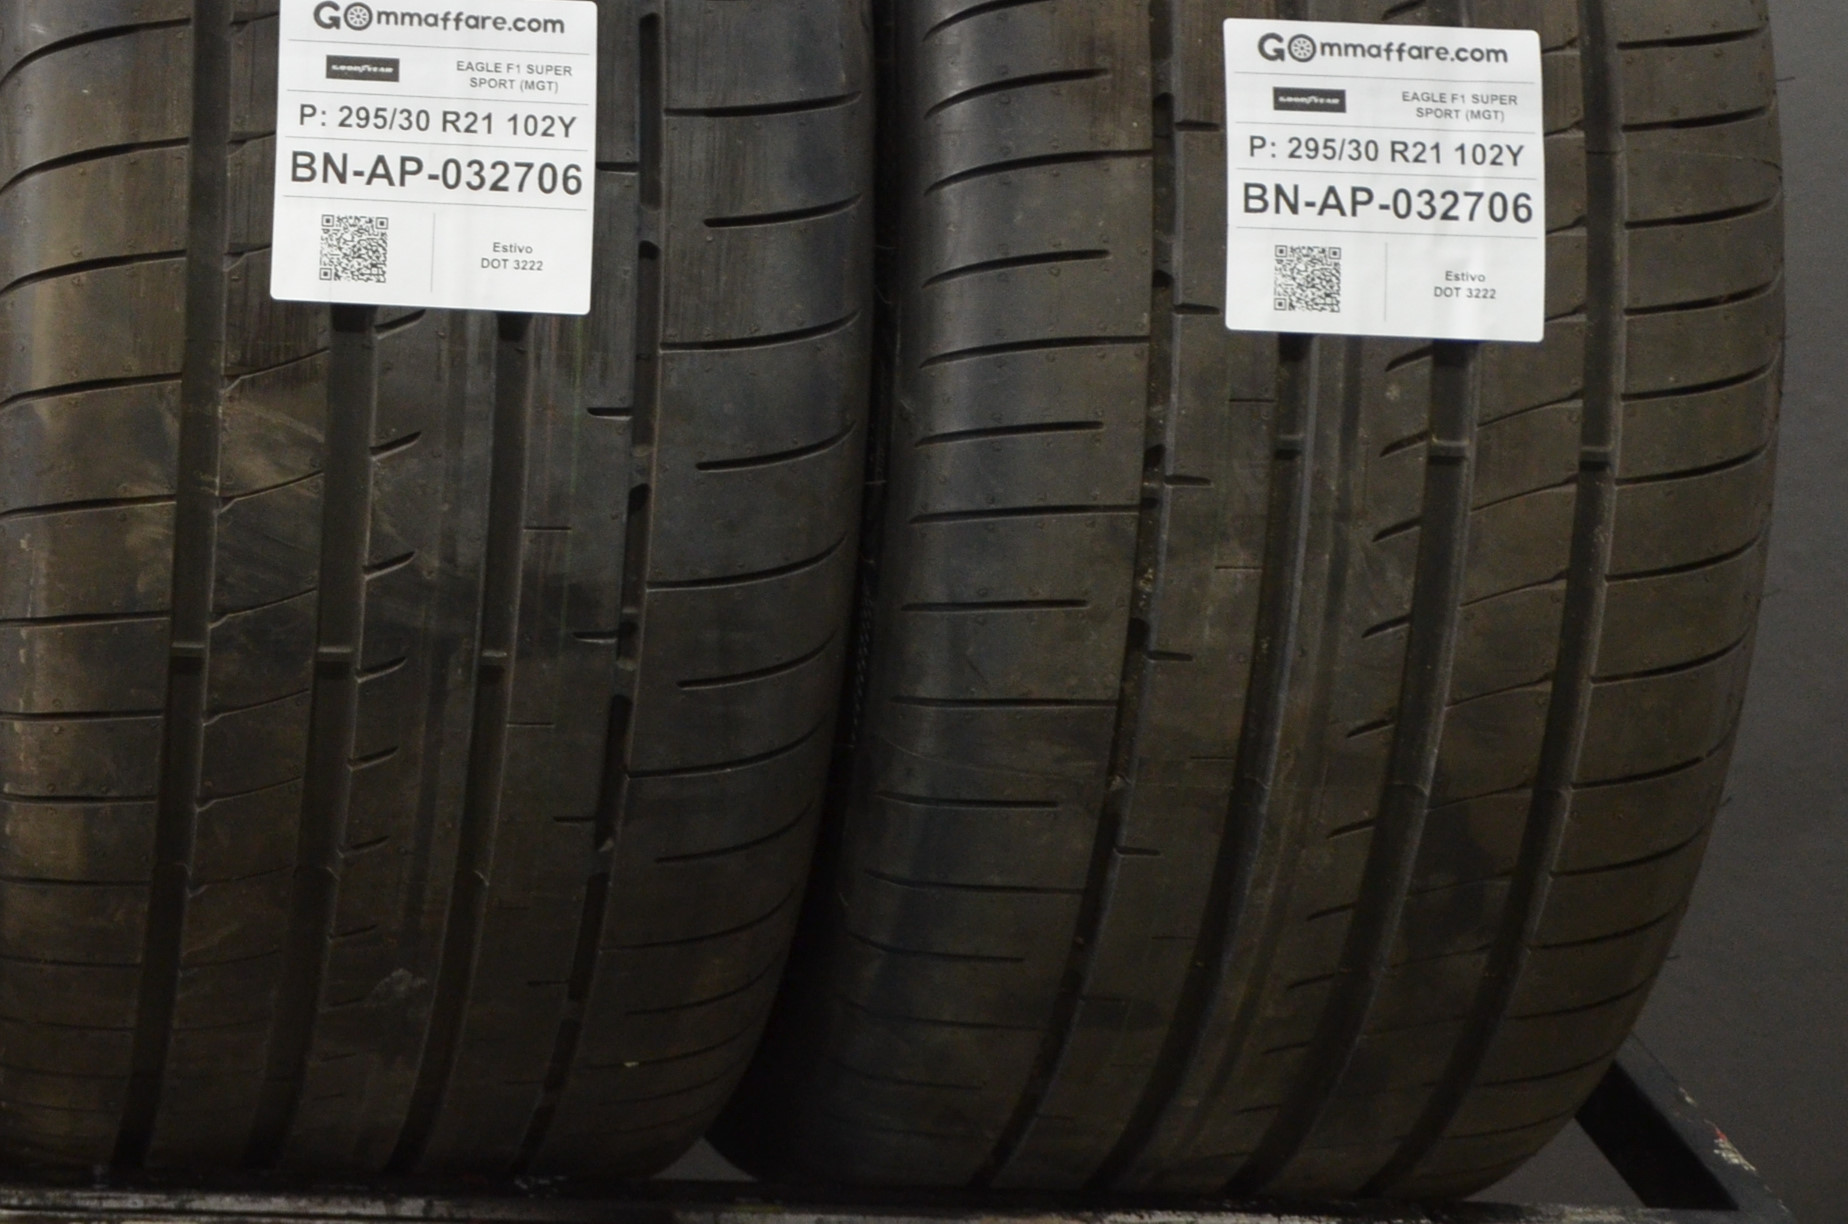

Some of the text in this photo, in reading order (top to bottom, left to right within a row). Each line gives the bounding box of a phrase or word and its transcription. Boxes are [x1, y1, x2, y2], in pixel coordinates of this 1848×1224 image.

[456, 60, 573, 77] EAGLE F1 SUPER
[469, 76, 559, 94] SPORT (MGT)
[1401, 90, 1518, 106] EAGLE F1 SUPER
[299, 103, 577, 138] P: 295/30 R21 102Y
[1415, 106, 1505, 123] SPORT (MGT)
[1249, 135, 1524, 167] P: 295/30 R21 102Y
[291, 150, 583, 196] BN-AP-032706
[1243, 182, 1533, 224] BN-AP-032706
[492, 241, 533, 254] Estivo
[480, 257, 544, 272] DOT 3222
[1444, 269, 1486, 283] Estivo
[1433, 285, 1497, 300] DOT 3222
